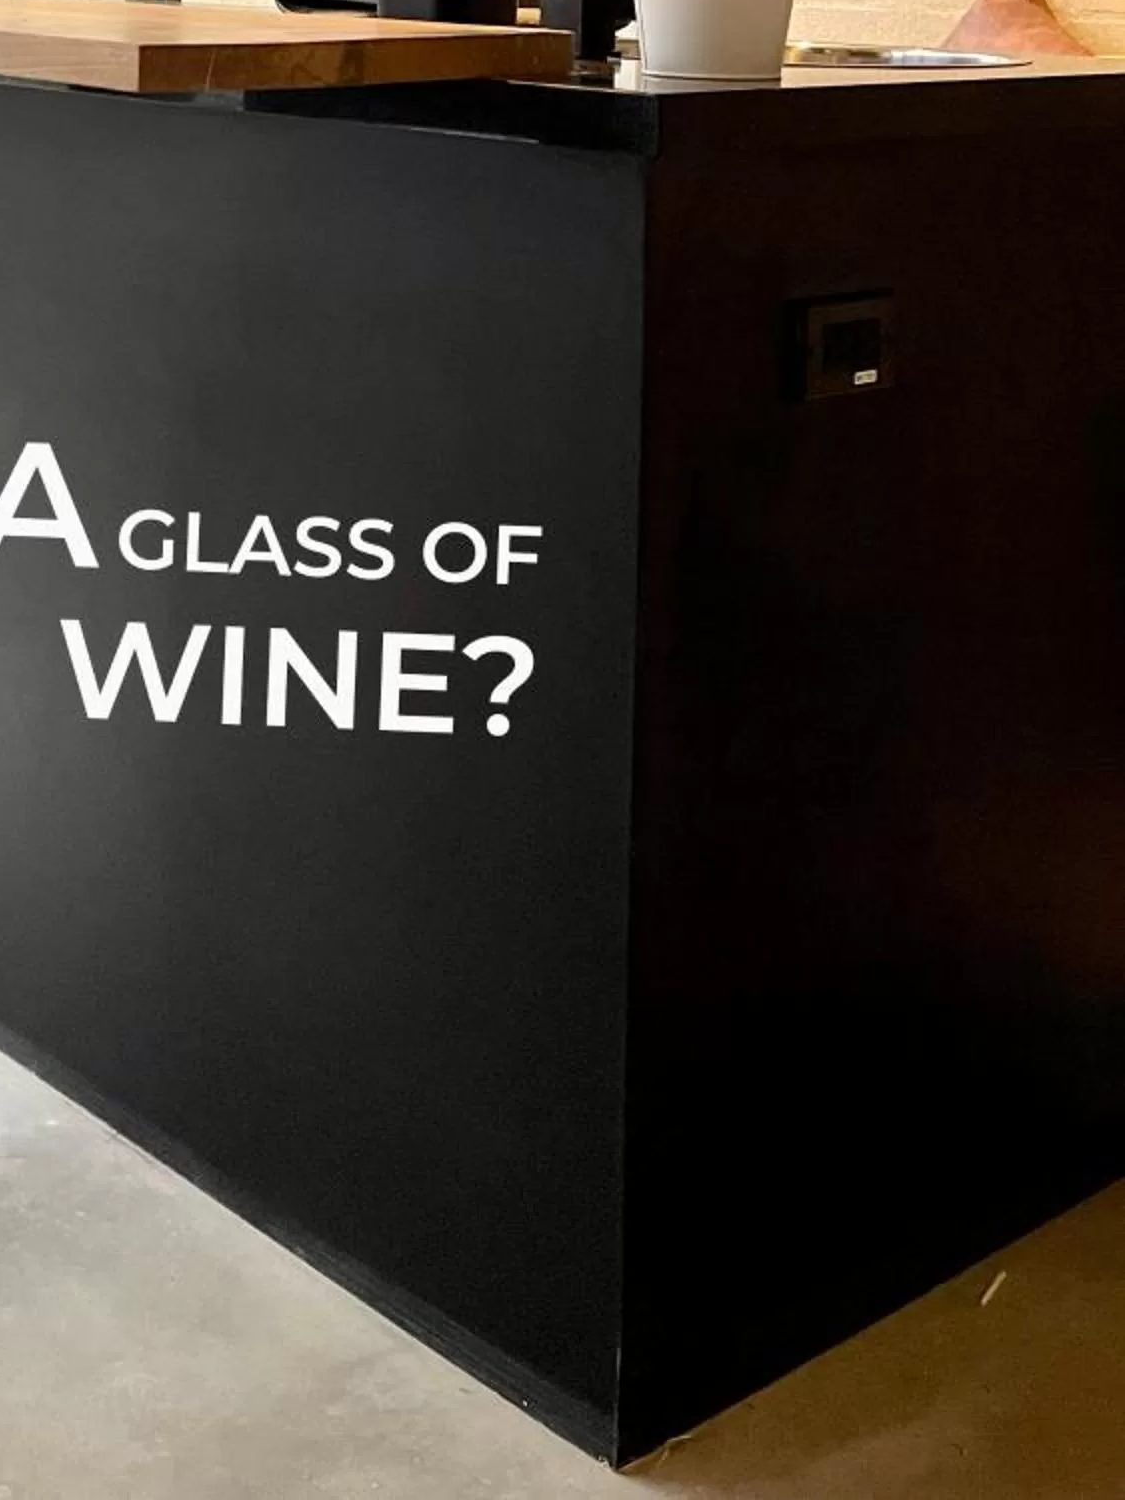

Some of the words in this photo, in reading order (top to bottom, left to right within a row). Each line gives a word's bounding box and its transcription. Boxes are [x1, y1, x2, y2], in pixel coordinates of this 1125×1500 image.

[119, 509, 396, 581] GLASS
[422, 521, 543, 585] OF
[60, 618, 534, 737] WINE?
